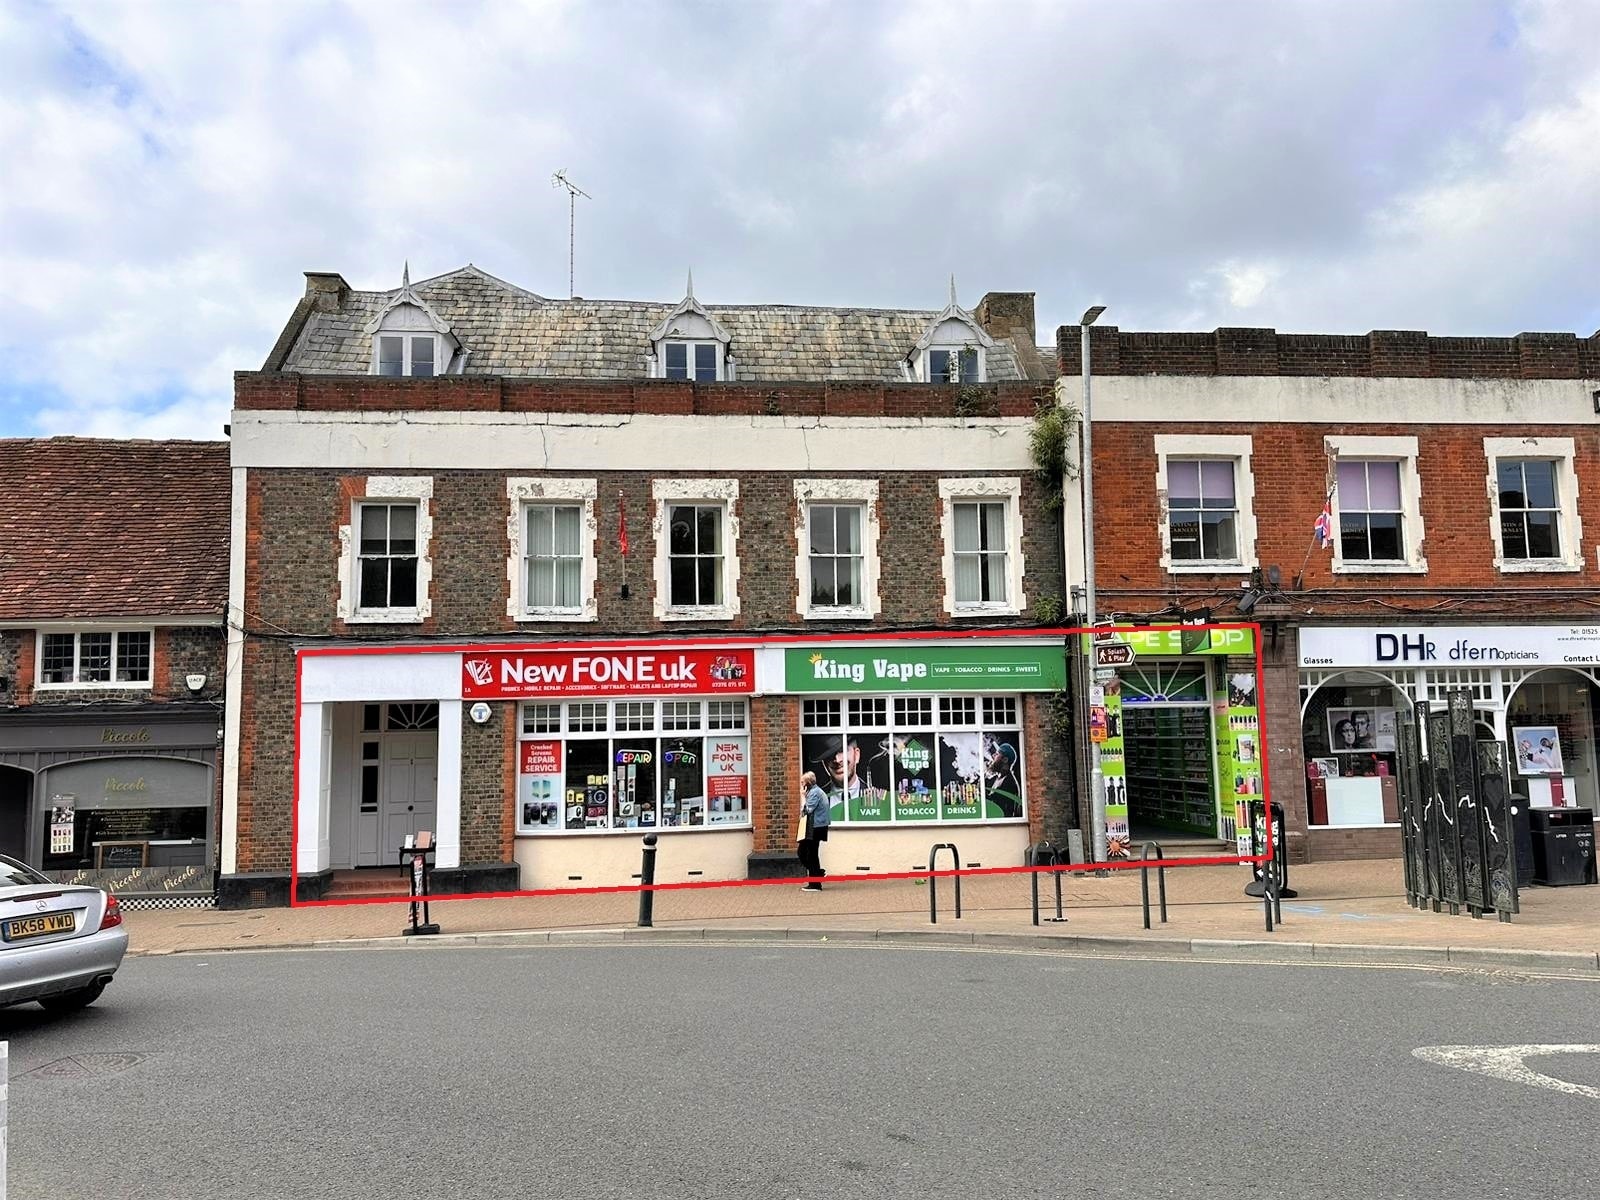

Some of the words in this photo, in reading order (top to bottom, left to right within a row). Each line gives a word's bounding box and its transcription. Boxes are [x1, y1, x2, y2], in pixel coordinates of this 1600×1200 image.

[1168, 629, 1244, 647] SOP
[1107, 648, 1126, 656] Splash
[1498, 650, 1539, 661] Opticians
[1113, 655, 1126, 663] Play
[1303, 657, 1334, 665] Glasses
[501, 658, 567, 684] New
[573, 656, 656, 683] FONE
[660, 656, 697, 682] uk
[814, 659, 865, 683] King
[873, 658, 928, 682] Vape
[1015, 665, 1038, 673] SWEETS
[101, 727, 152, 744] Piccolo
[716, 743, 739, 752] NEW
[616, 752, 651, 764] REPAIR
[712, 753, 743, 763] FONE
[901, 747, 929, 760] King
[527, 756, 556, 764] REPAIR
[902, 759, 930, 771] Vape
[525, 764, 558, 773] SERVICE
[720, 763, 735, 773] UK
[860, 808, 881, 816] VAPE
[947, 806, 977, 815] DRINKS
[1256, 813, 1278, 835] Kig
[1256, 831, 1278, 846] Vae
[109, 867, 142, 893] Piccolo
[164, 865, 196, 892] Piccolo
[11, 918, 46, 935] BK58
[48, 915, 72, 929] VWD
